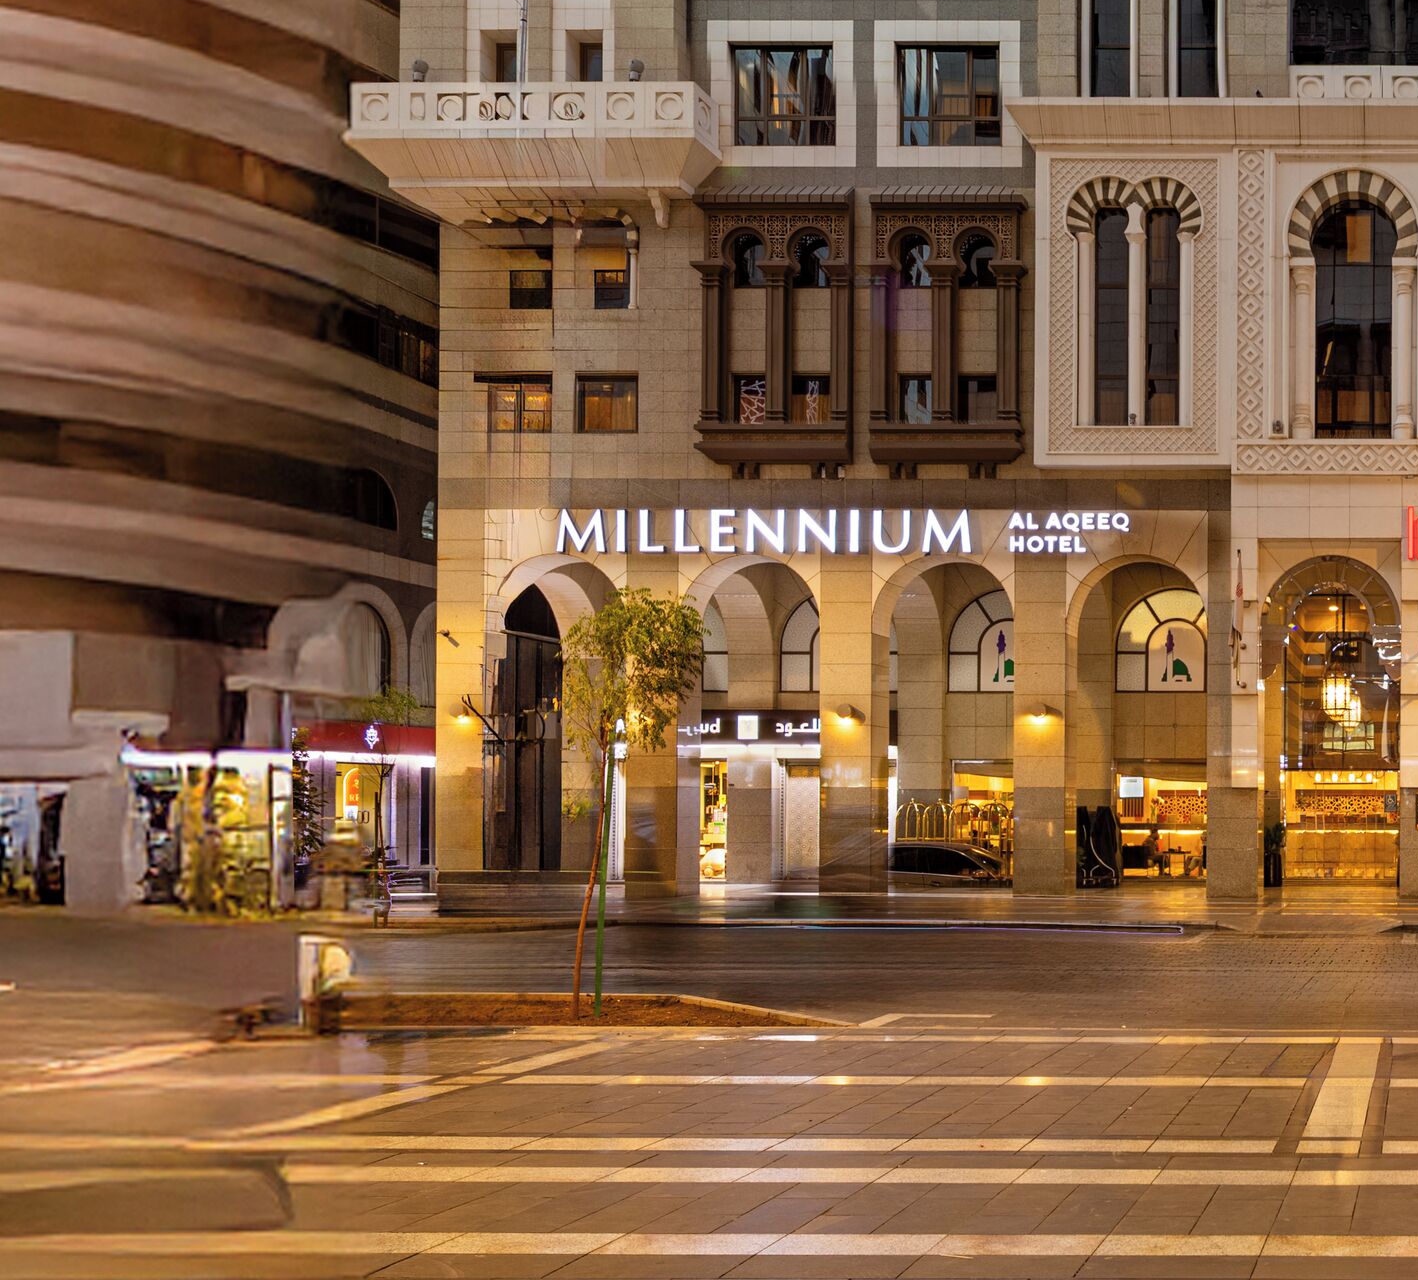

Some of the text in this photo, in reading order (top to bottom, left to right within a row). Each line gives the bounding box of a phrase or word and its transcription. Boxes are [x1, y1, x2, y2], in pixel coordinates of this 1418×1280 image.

[555, 508, 972, 555] MILLENNIUM
[1008, 512, 1130, 532] AL AQEEQ
[1009, 535, 1087, 553] HOTEL
